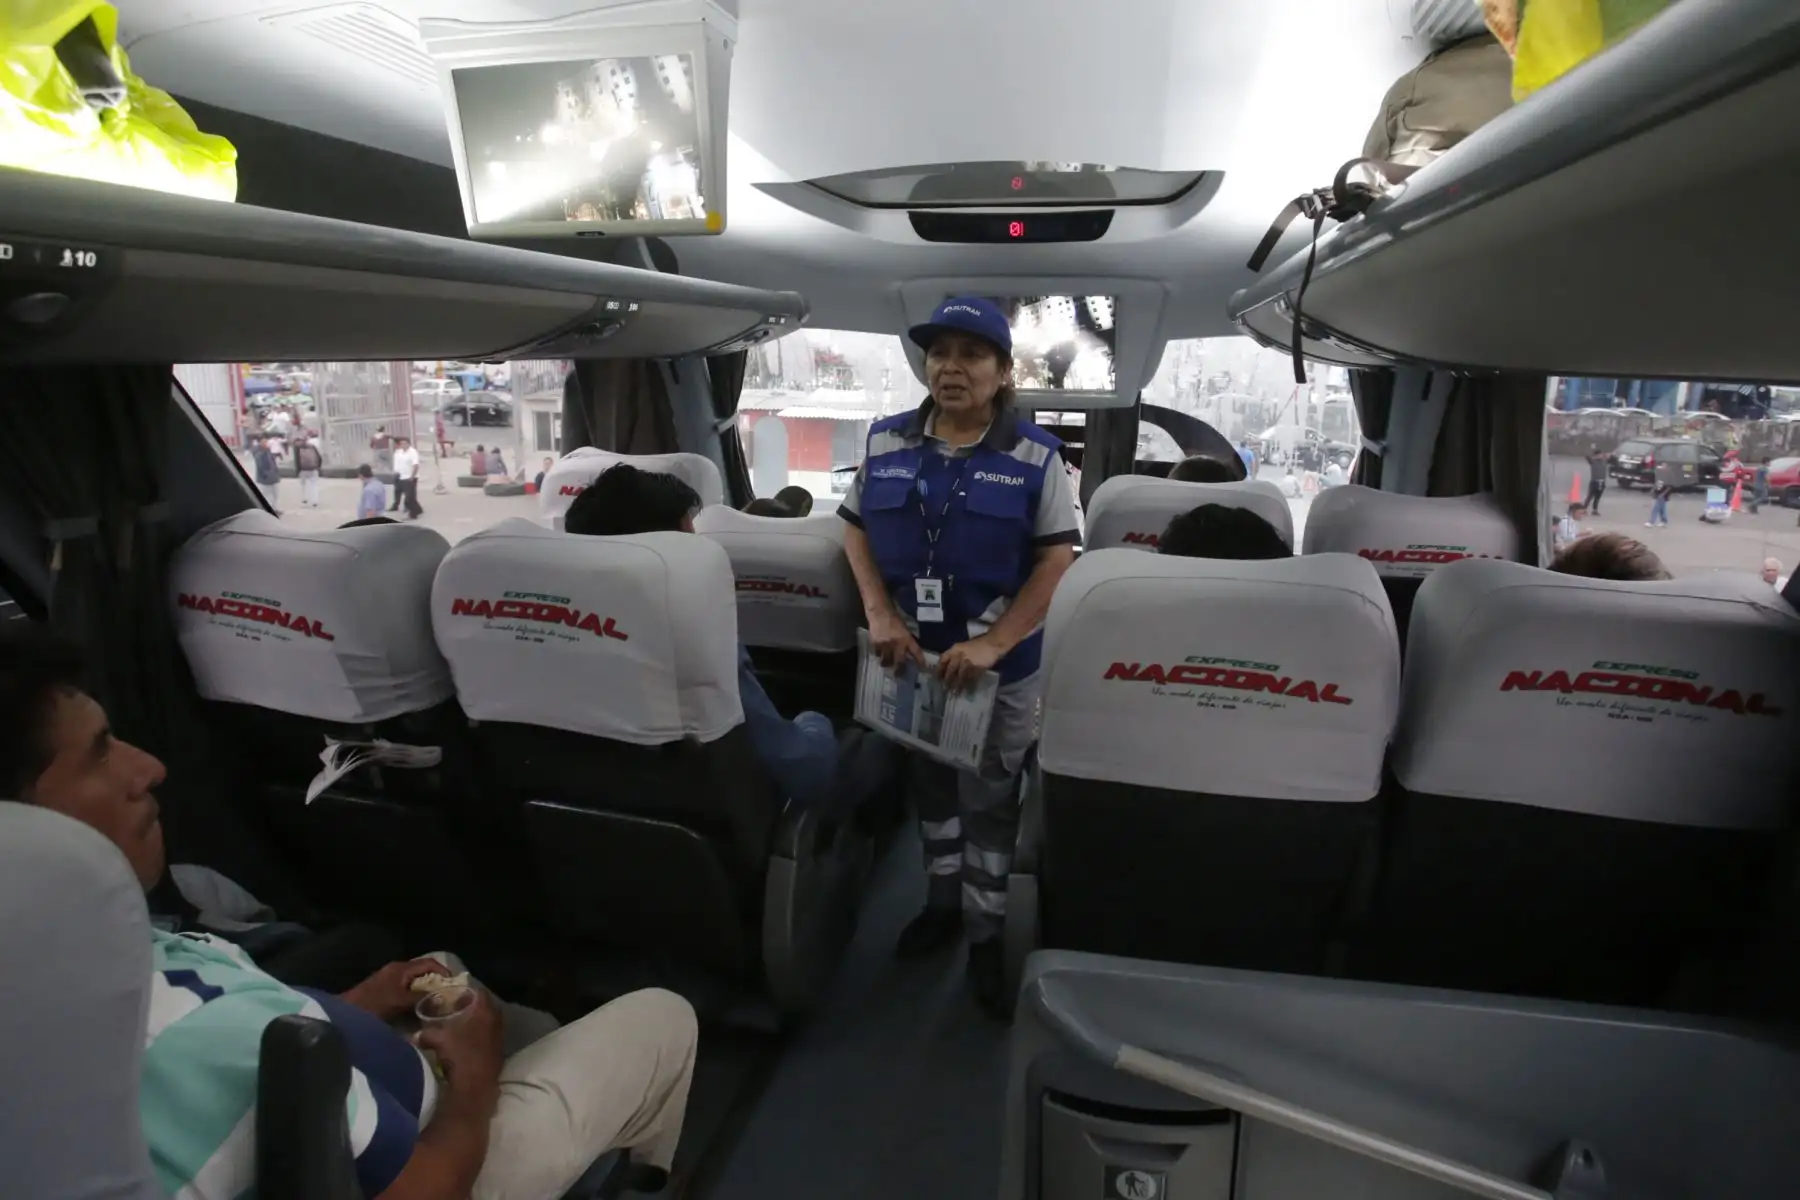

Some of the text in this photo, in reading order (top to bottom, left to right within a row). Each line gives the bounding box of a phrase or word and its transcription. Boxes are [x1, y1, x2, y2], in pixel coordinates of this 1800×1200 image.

[75, 250, 97, 267] 10
[952, 305, 981, 317] SUTRAN
[986, 473, 1025, 486] SUTRAN
[503, 591, 572, 606] EXPRESO
[734, 580, 829, 599] CIONAL
[178, 592, 335, 642] NACIONAL
[451, 598, 629, 642] NACIONAL
[1184, 655, 1281, 672] EXPRESO
[1592, 660, 1700, 681] EXPRESO
[1103, 662, 1354, 706] NACIONAL
[1499, 670, 1785, 719] NACIONAL
